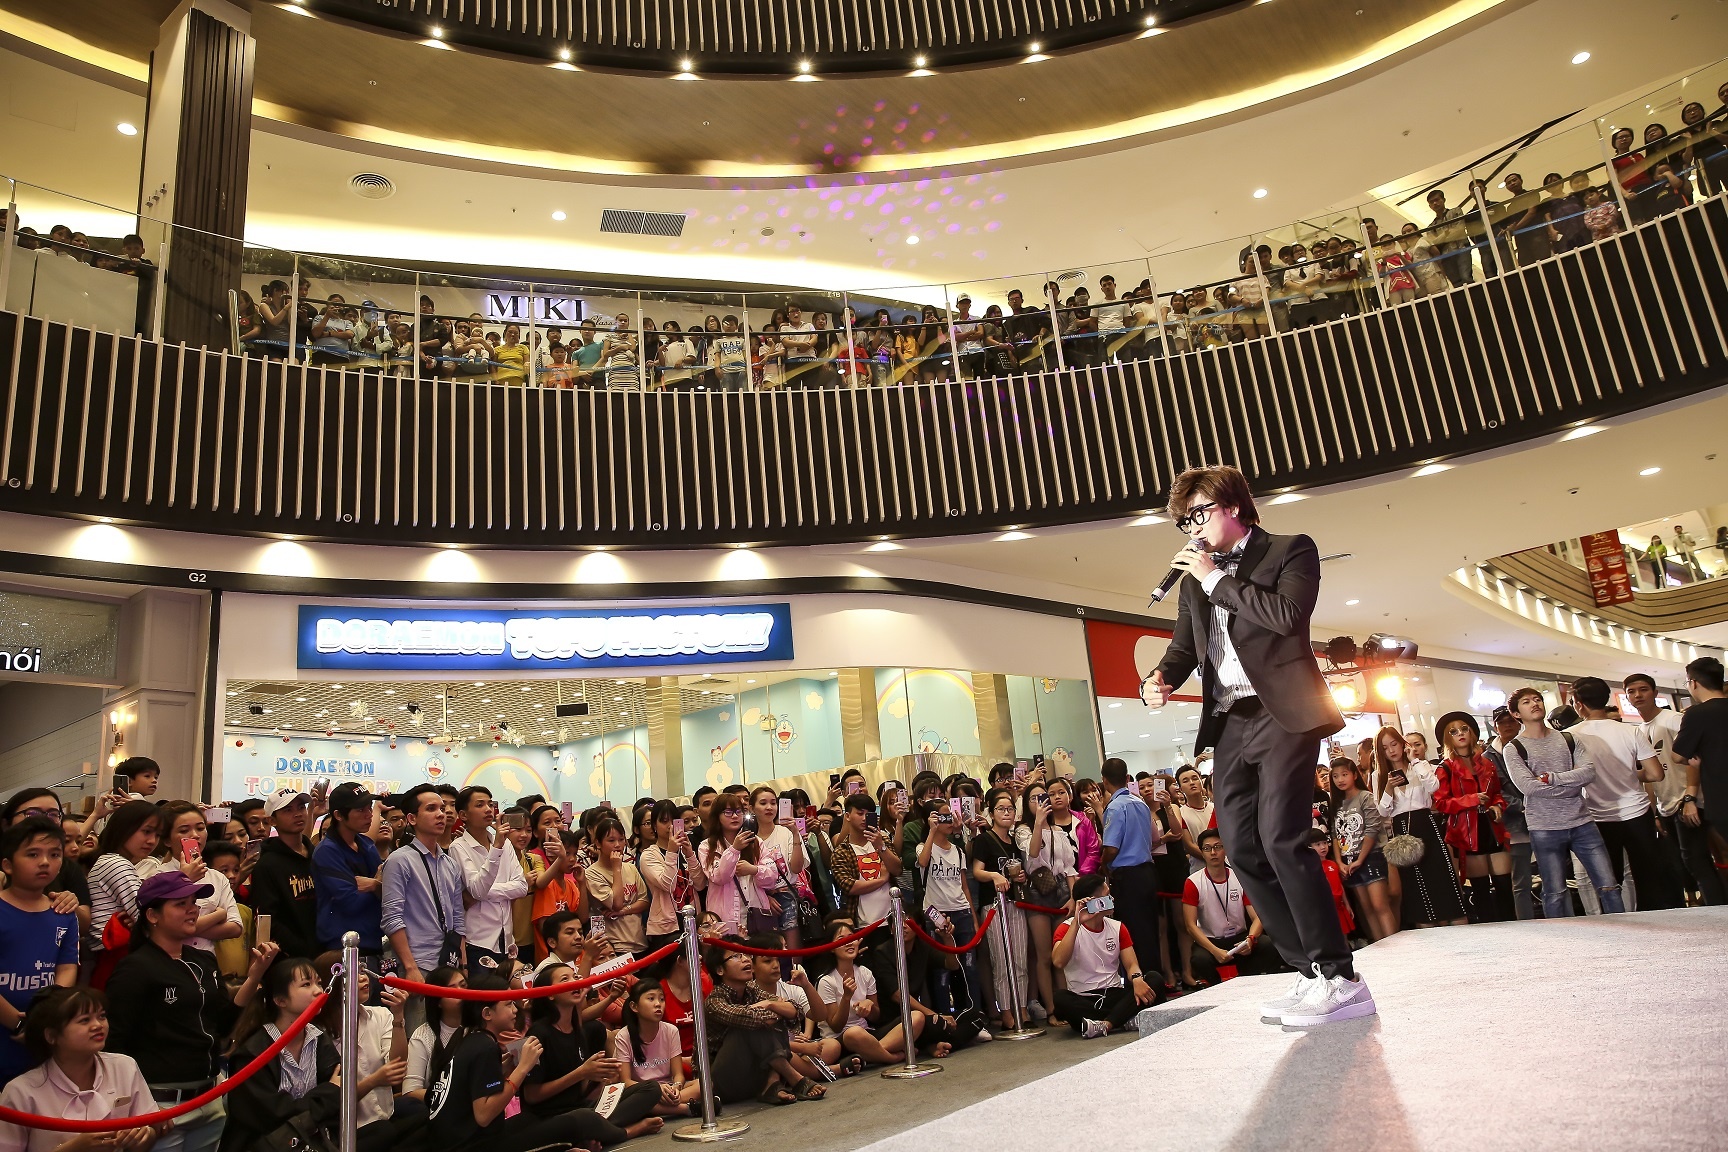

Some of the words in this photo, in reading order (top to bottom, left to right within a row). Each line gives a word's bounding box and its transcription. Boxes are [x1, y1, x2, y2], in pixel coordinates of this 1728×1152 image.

[722, 340, 741, 348] GAP
[188, 572, 206, 583] G2
[1076, 607, 1085, 615] G3
[316, 618, 505, 656] DORAEMON
[275, 756, 376, 776] DORAEMON
[245, 776, 302, 797] TOFU
